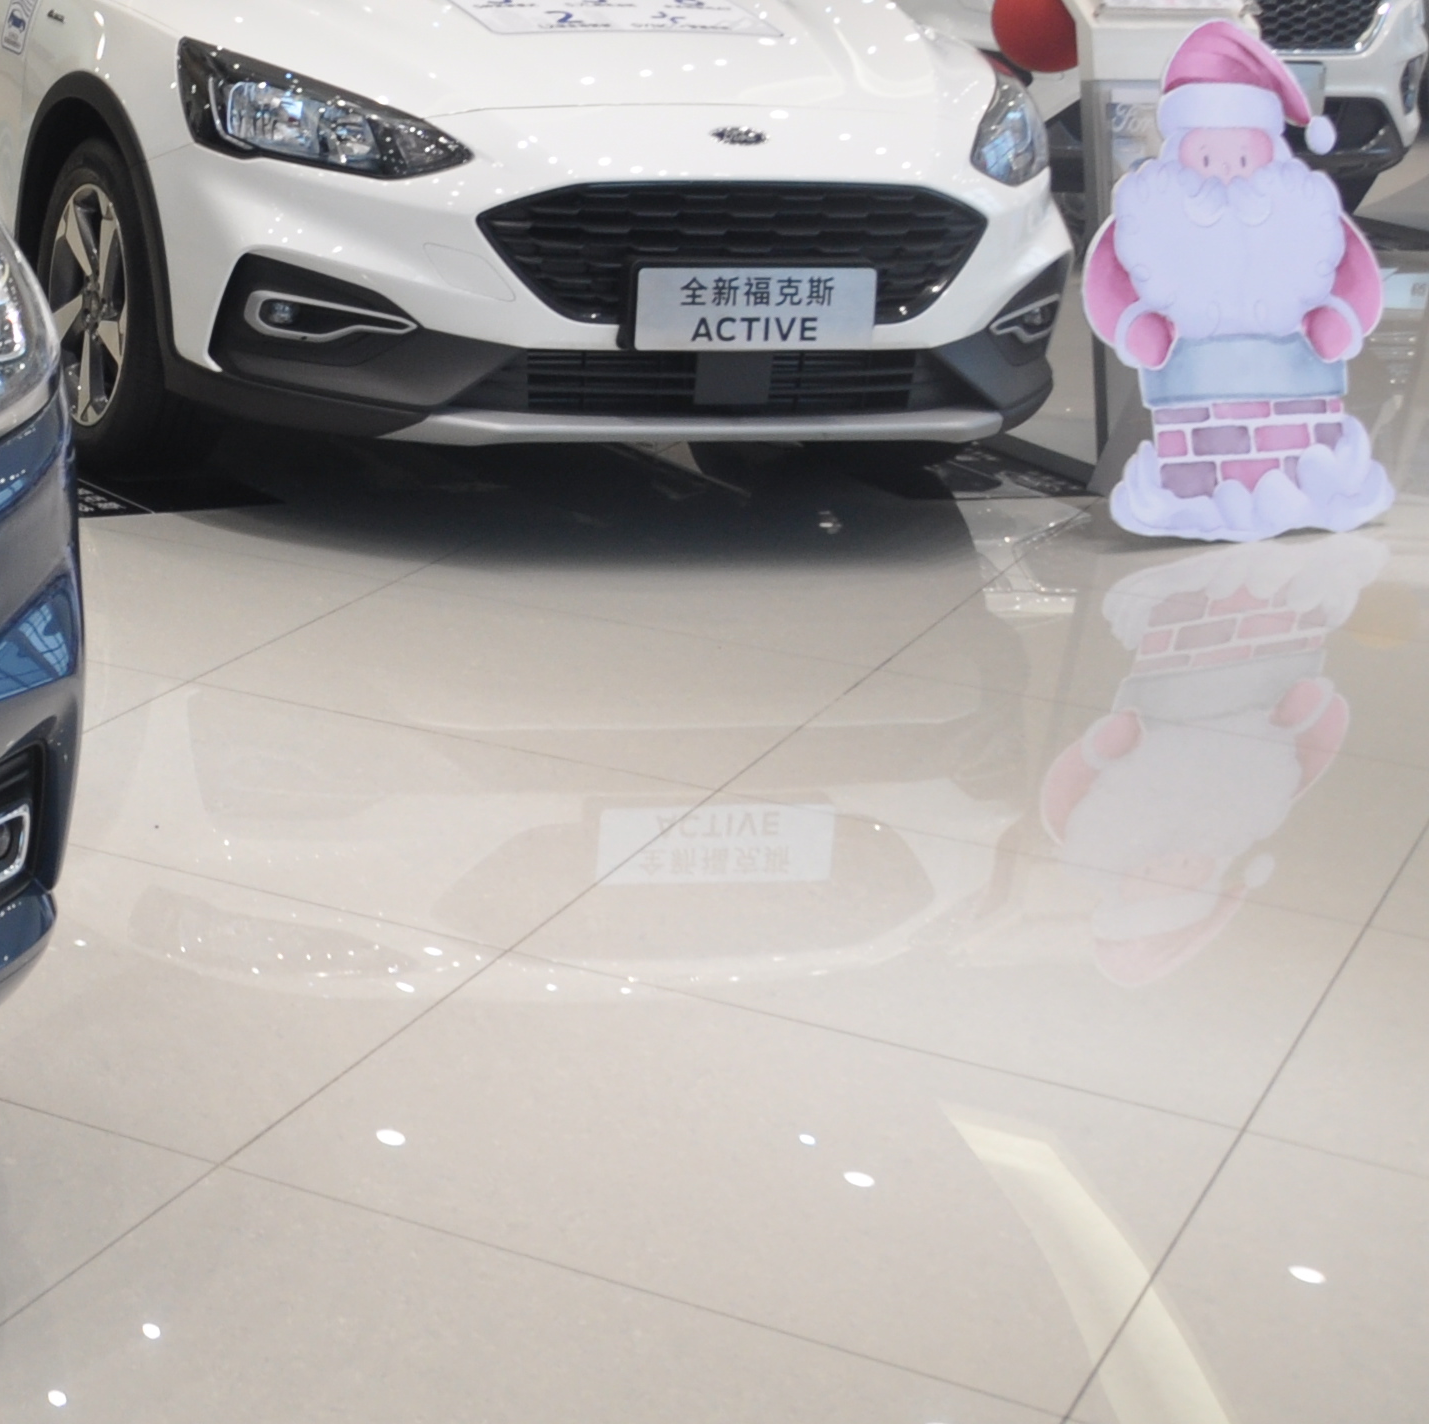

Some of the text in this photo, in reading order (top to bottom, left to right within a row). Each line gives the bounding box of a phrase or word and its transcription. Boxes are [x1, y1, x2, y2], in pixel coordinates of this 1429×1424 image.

[680, 277, 836, 307] 全新福克斯
[691, 316, 819, 343] ACTIVE
